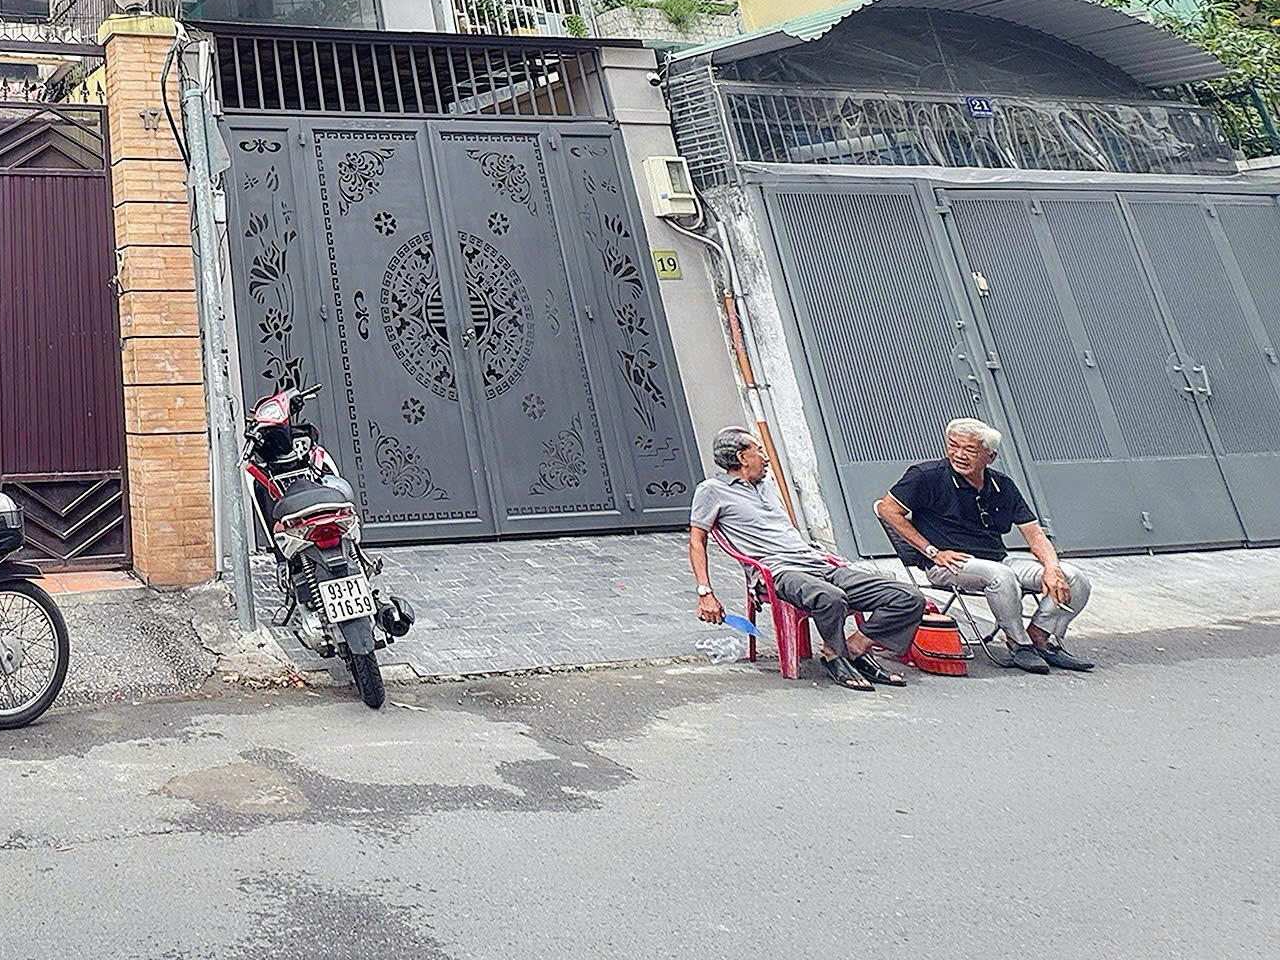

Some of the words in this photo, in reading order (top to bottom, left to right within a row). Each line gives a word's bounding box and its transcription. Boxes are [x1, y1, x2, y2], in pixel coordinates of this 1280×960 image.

[971, 100, 990, 110] 21
[139, 108, 162, 131] 17
[657, 257, 677, 271] 19
[328, 580, 362, 600] 93-P1
[329, 596, 372, 618] 316.59
